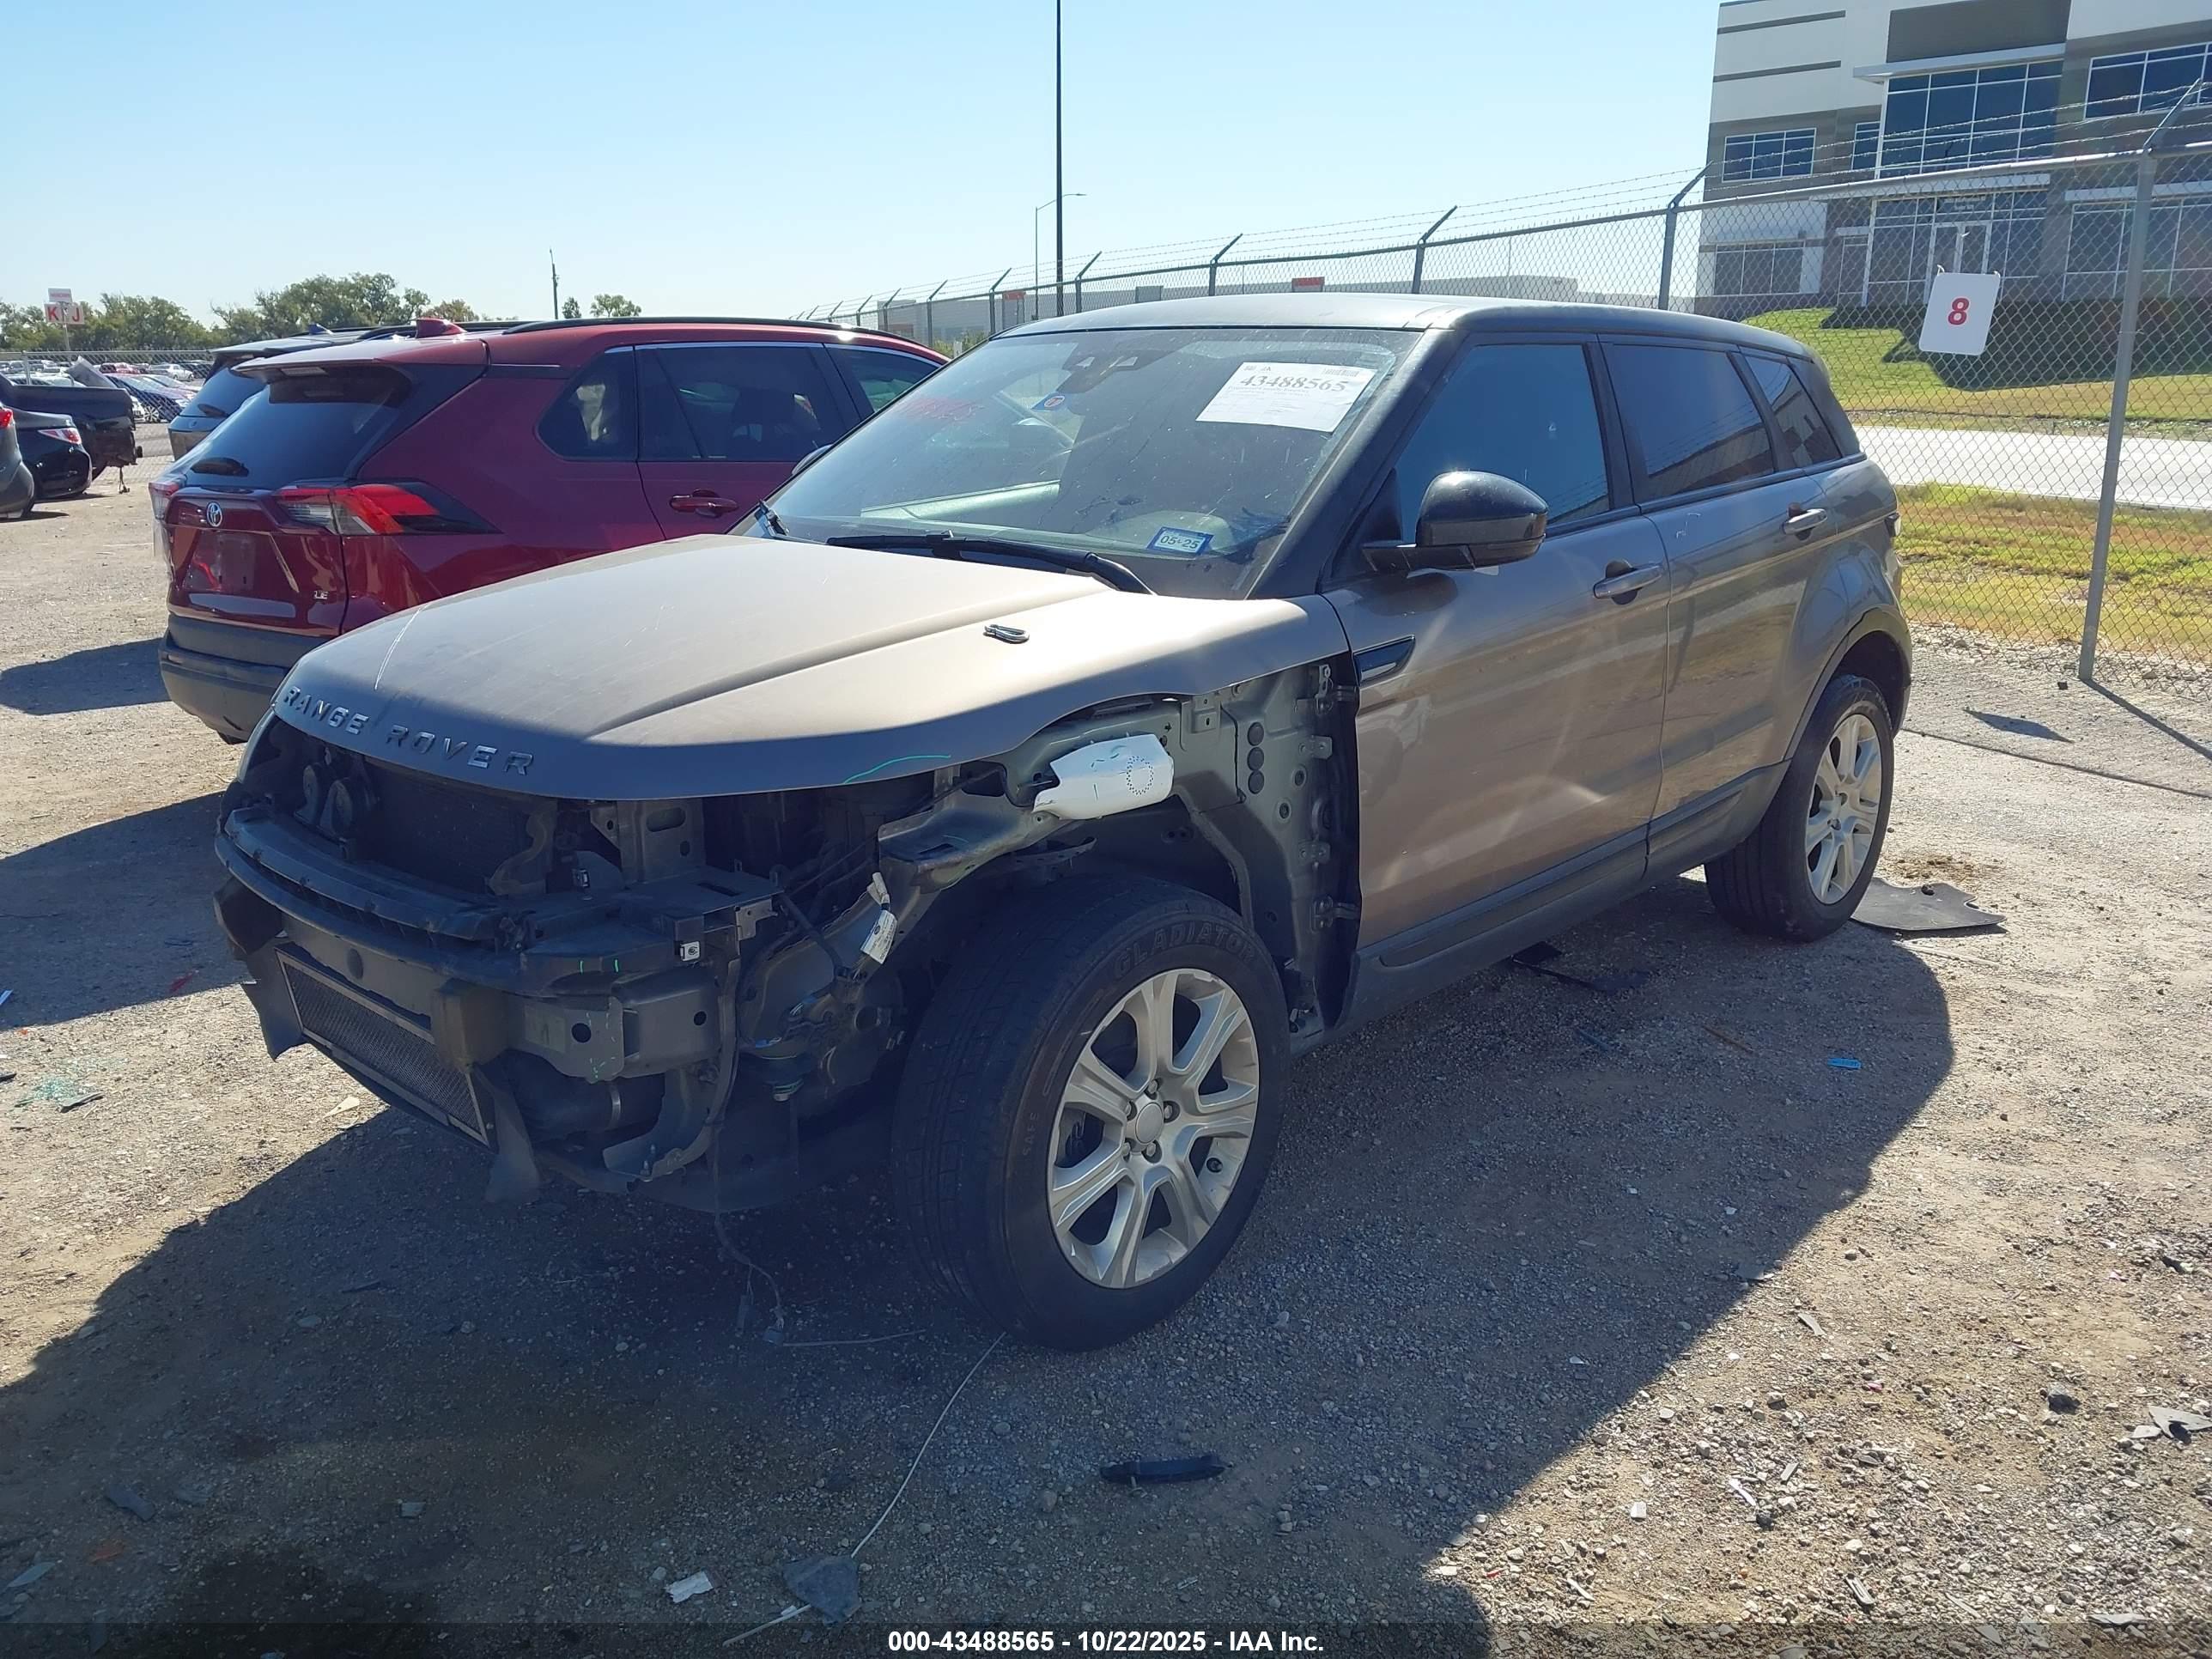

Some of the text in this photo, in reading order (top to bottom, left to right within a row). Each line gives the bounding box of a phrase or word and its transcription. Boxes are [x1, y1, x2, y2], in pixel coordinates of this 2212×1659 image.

[47, 306, 81, 323] K J
[1948, 297, 1970, 325] 8
[1239, 374, 1349, 392] 43488565
[283, 685, 534, 776] RANGE ROVER
[1116, 920, 1255, 974] GLADIATOR
